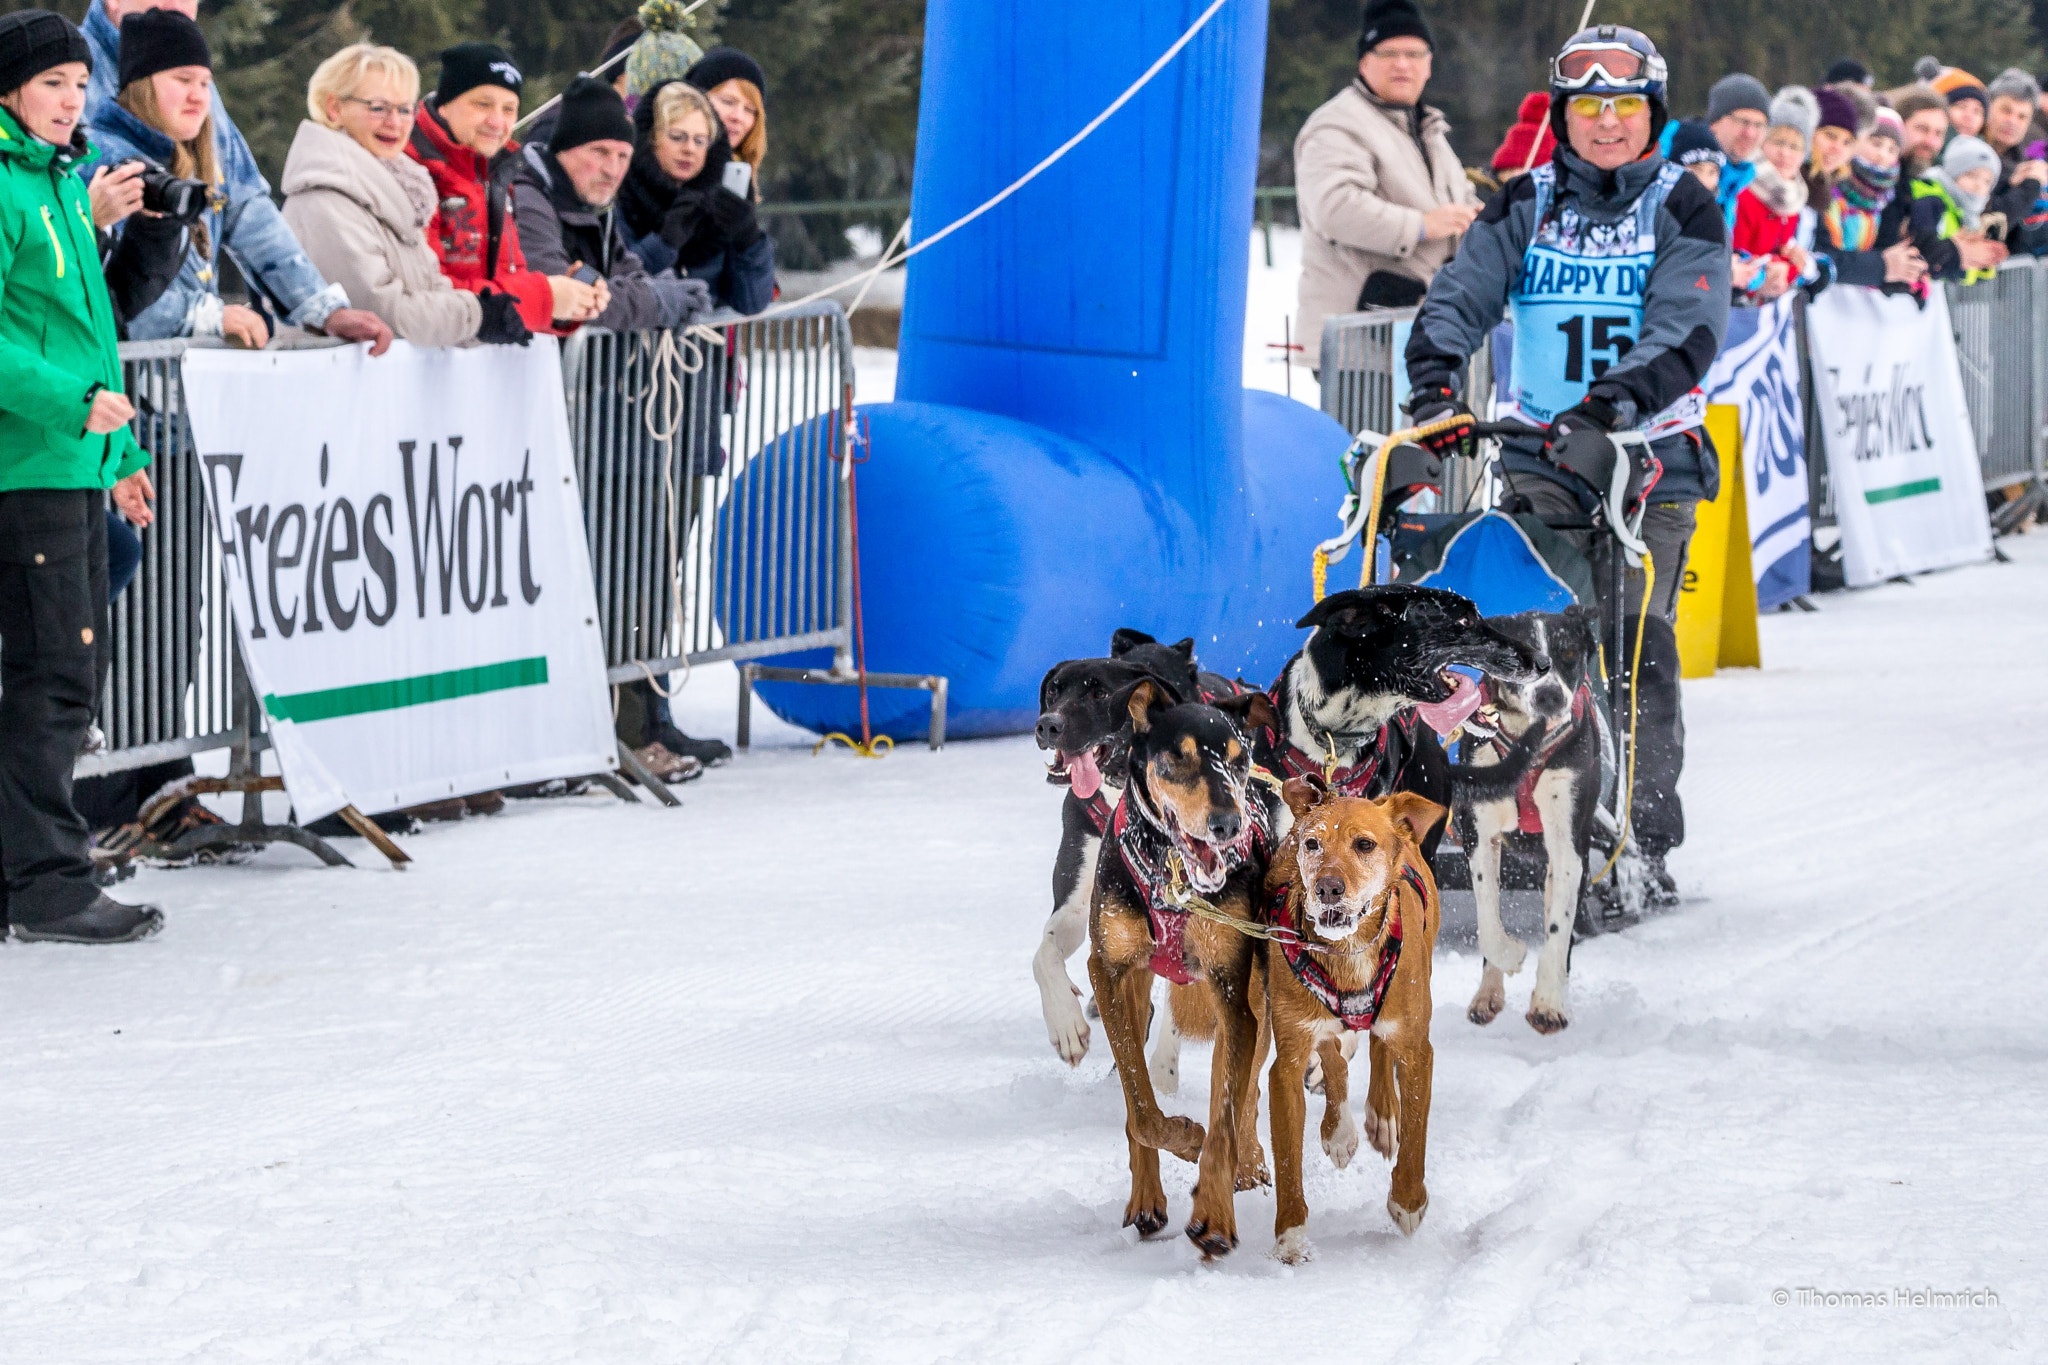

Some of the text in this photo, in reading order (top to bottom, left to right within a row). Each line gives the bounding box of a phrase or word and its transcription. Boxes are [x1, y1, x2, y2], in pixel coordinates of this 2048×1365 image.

[1519, 254, 1611, 295] HAPPY
[1557, 314, 1635, 382] 15
[203, 436, 542, 638] Freies Wort
